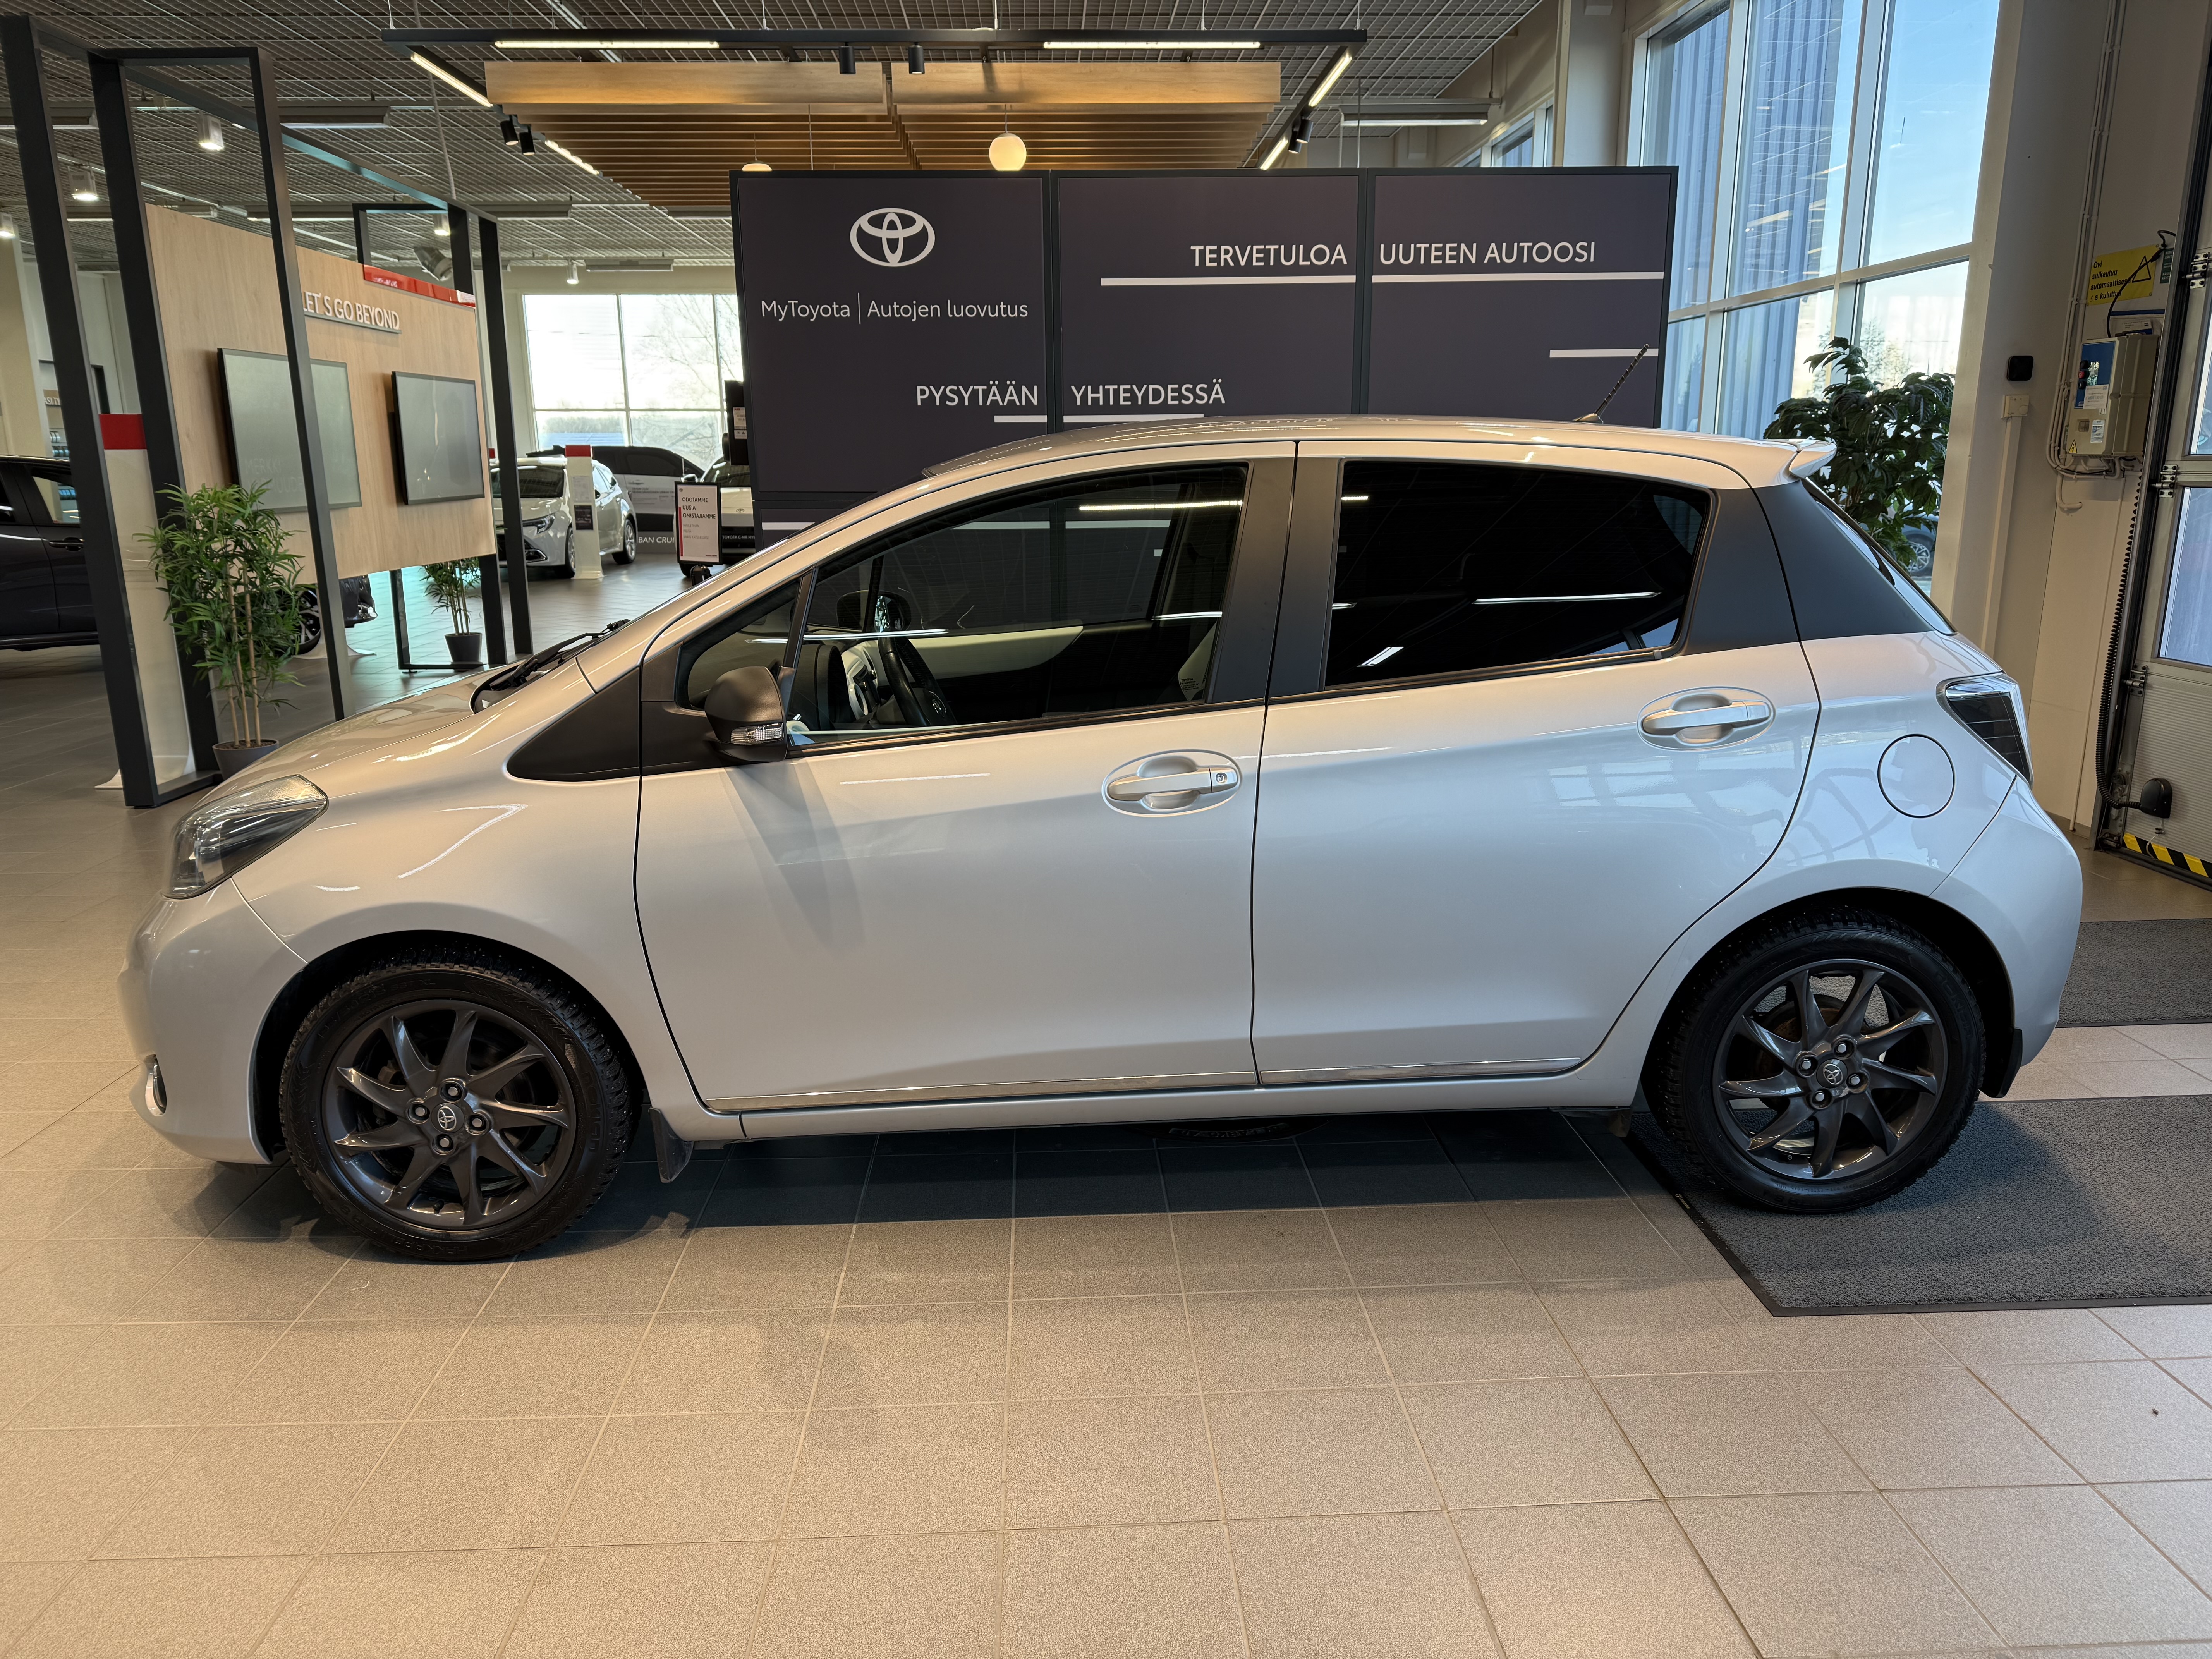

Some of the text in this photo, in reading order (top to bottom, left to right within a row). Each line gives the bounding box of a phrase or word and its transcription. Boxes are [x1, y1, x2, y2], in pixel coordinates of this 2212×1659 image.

[1190, 242, 1595, 266] TERVETULOA UUTEEN AUTOOSI
[2093, 260, 2102, 268] Ovi
[2092, 270, 2118, 279] sulkeutuu
[334, 298, 354, 321] GO
[355, 302, 400, 330] BEYOND
[761, 299, 1028, 322] MyToyota Autojen luovutus
[917, 378, 1225, 406] PYSYTÄÄN YHTEYDESSÄ
